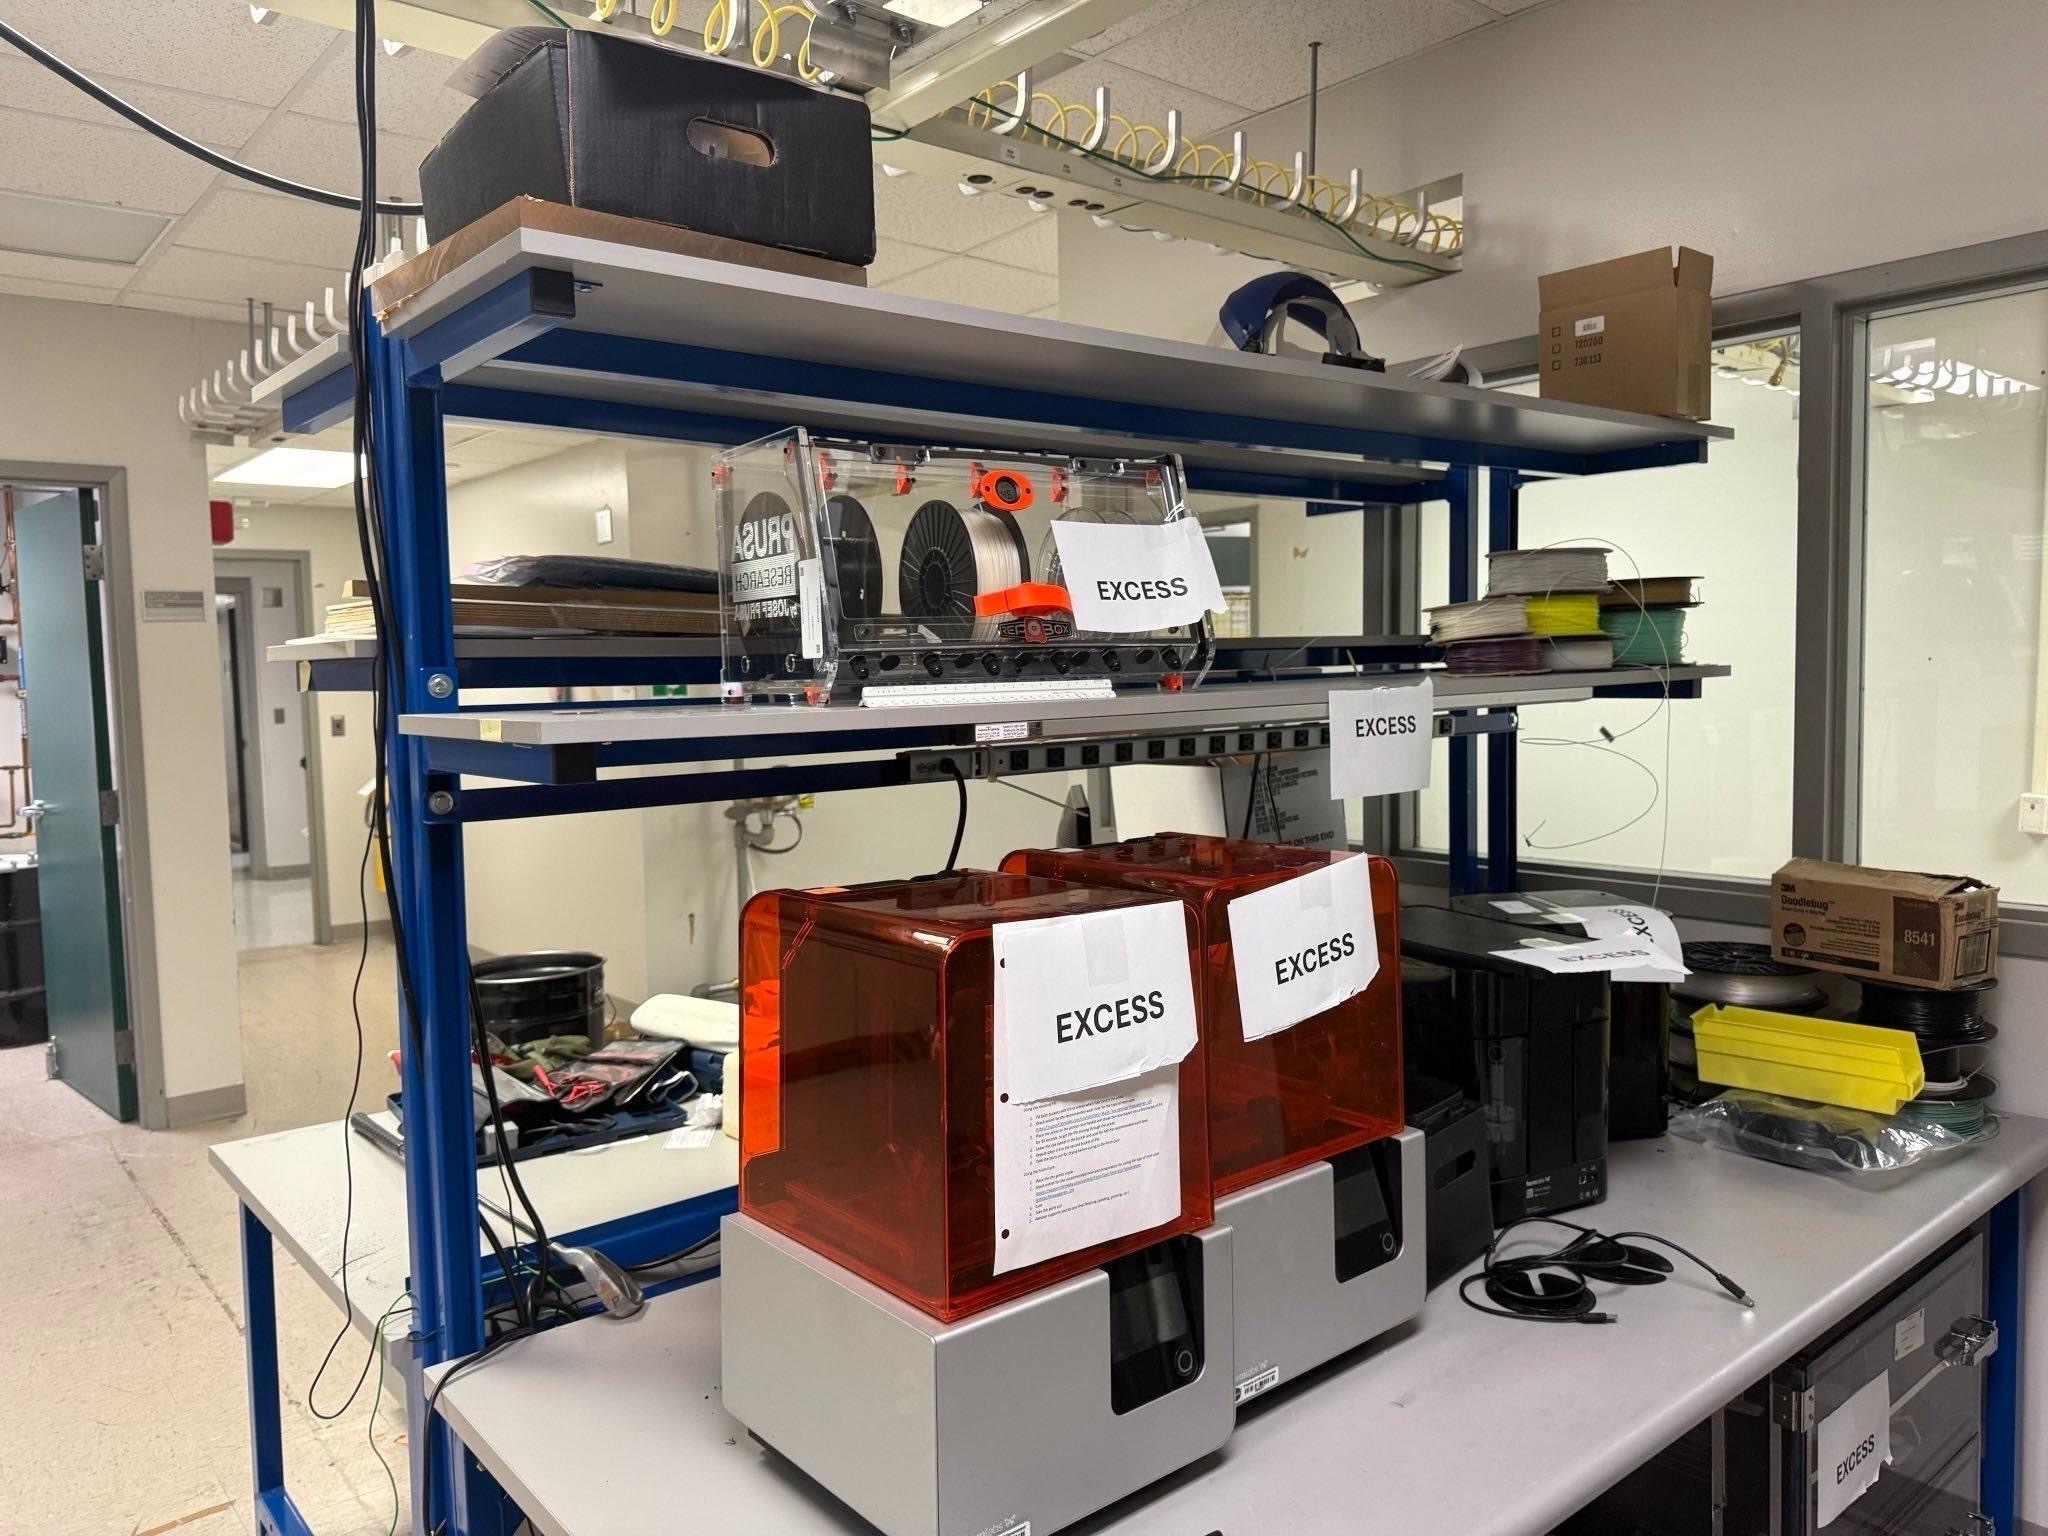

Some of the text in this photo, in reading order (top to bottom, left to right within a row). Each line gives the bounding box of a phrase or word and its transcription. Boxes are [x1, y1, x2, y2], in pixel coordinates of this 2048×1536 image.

[1097, 577, 1188, 602] EXCESS
[1356, 716, 1417, 737] EXCESS
[1321, 831, 1335, 842] END
[1781, 884, 1796, 893] 3M
[1904, 929, 1935, 947] 8541
[1275, 933, 1355, 985] EXCESS
[1558, 949, 1651, 962] EXCESS
[1056, 990, 1165, 1044] EXCESS
[1836, 1433, 1876, 1485] EXCESS
